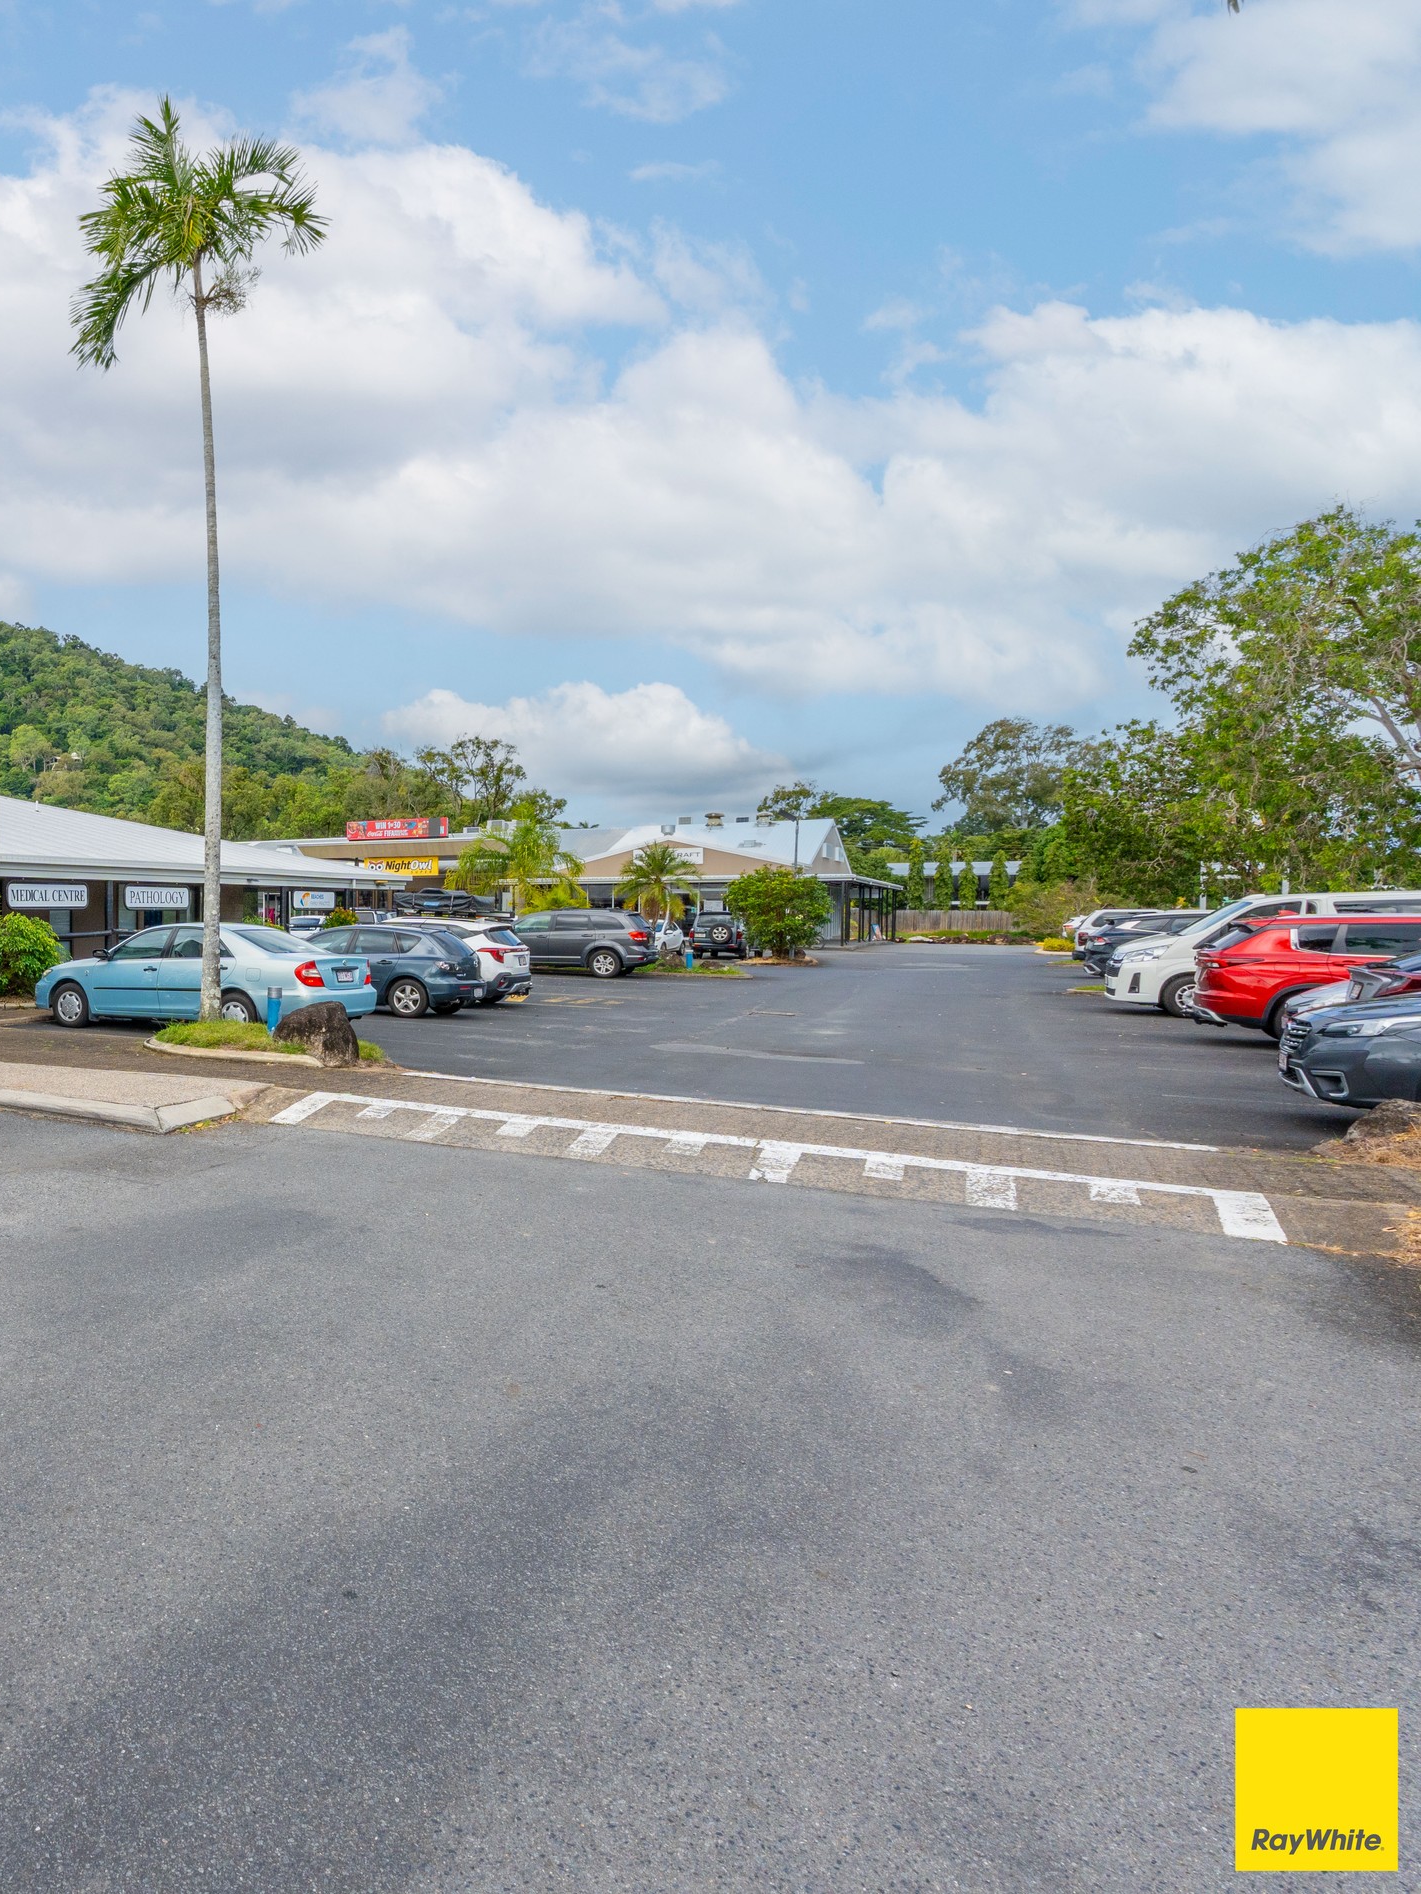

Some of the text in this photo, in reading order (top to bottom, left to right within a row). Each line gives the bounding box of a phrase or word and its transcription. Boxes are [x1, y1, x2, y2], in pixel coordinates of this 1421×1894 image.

[385, 859, 433, 873] NightOwl
[11, 889, 85, 902] MEDICAL CENTRE
[130, 890, 185, 904] PATHOLOGY
